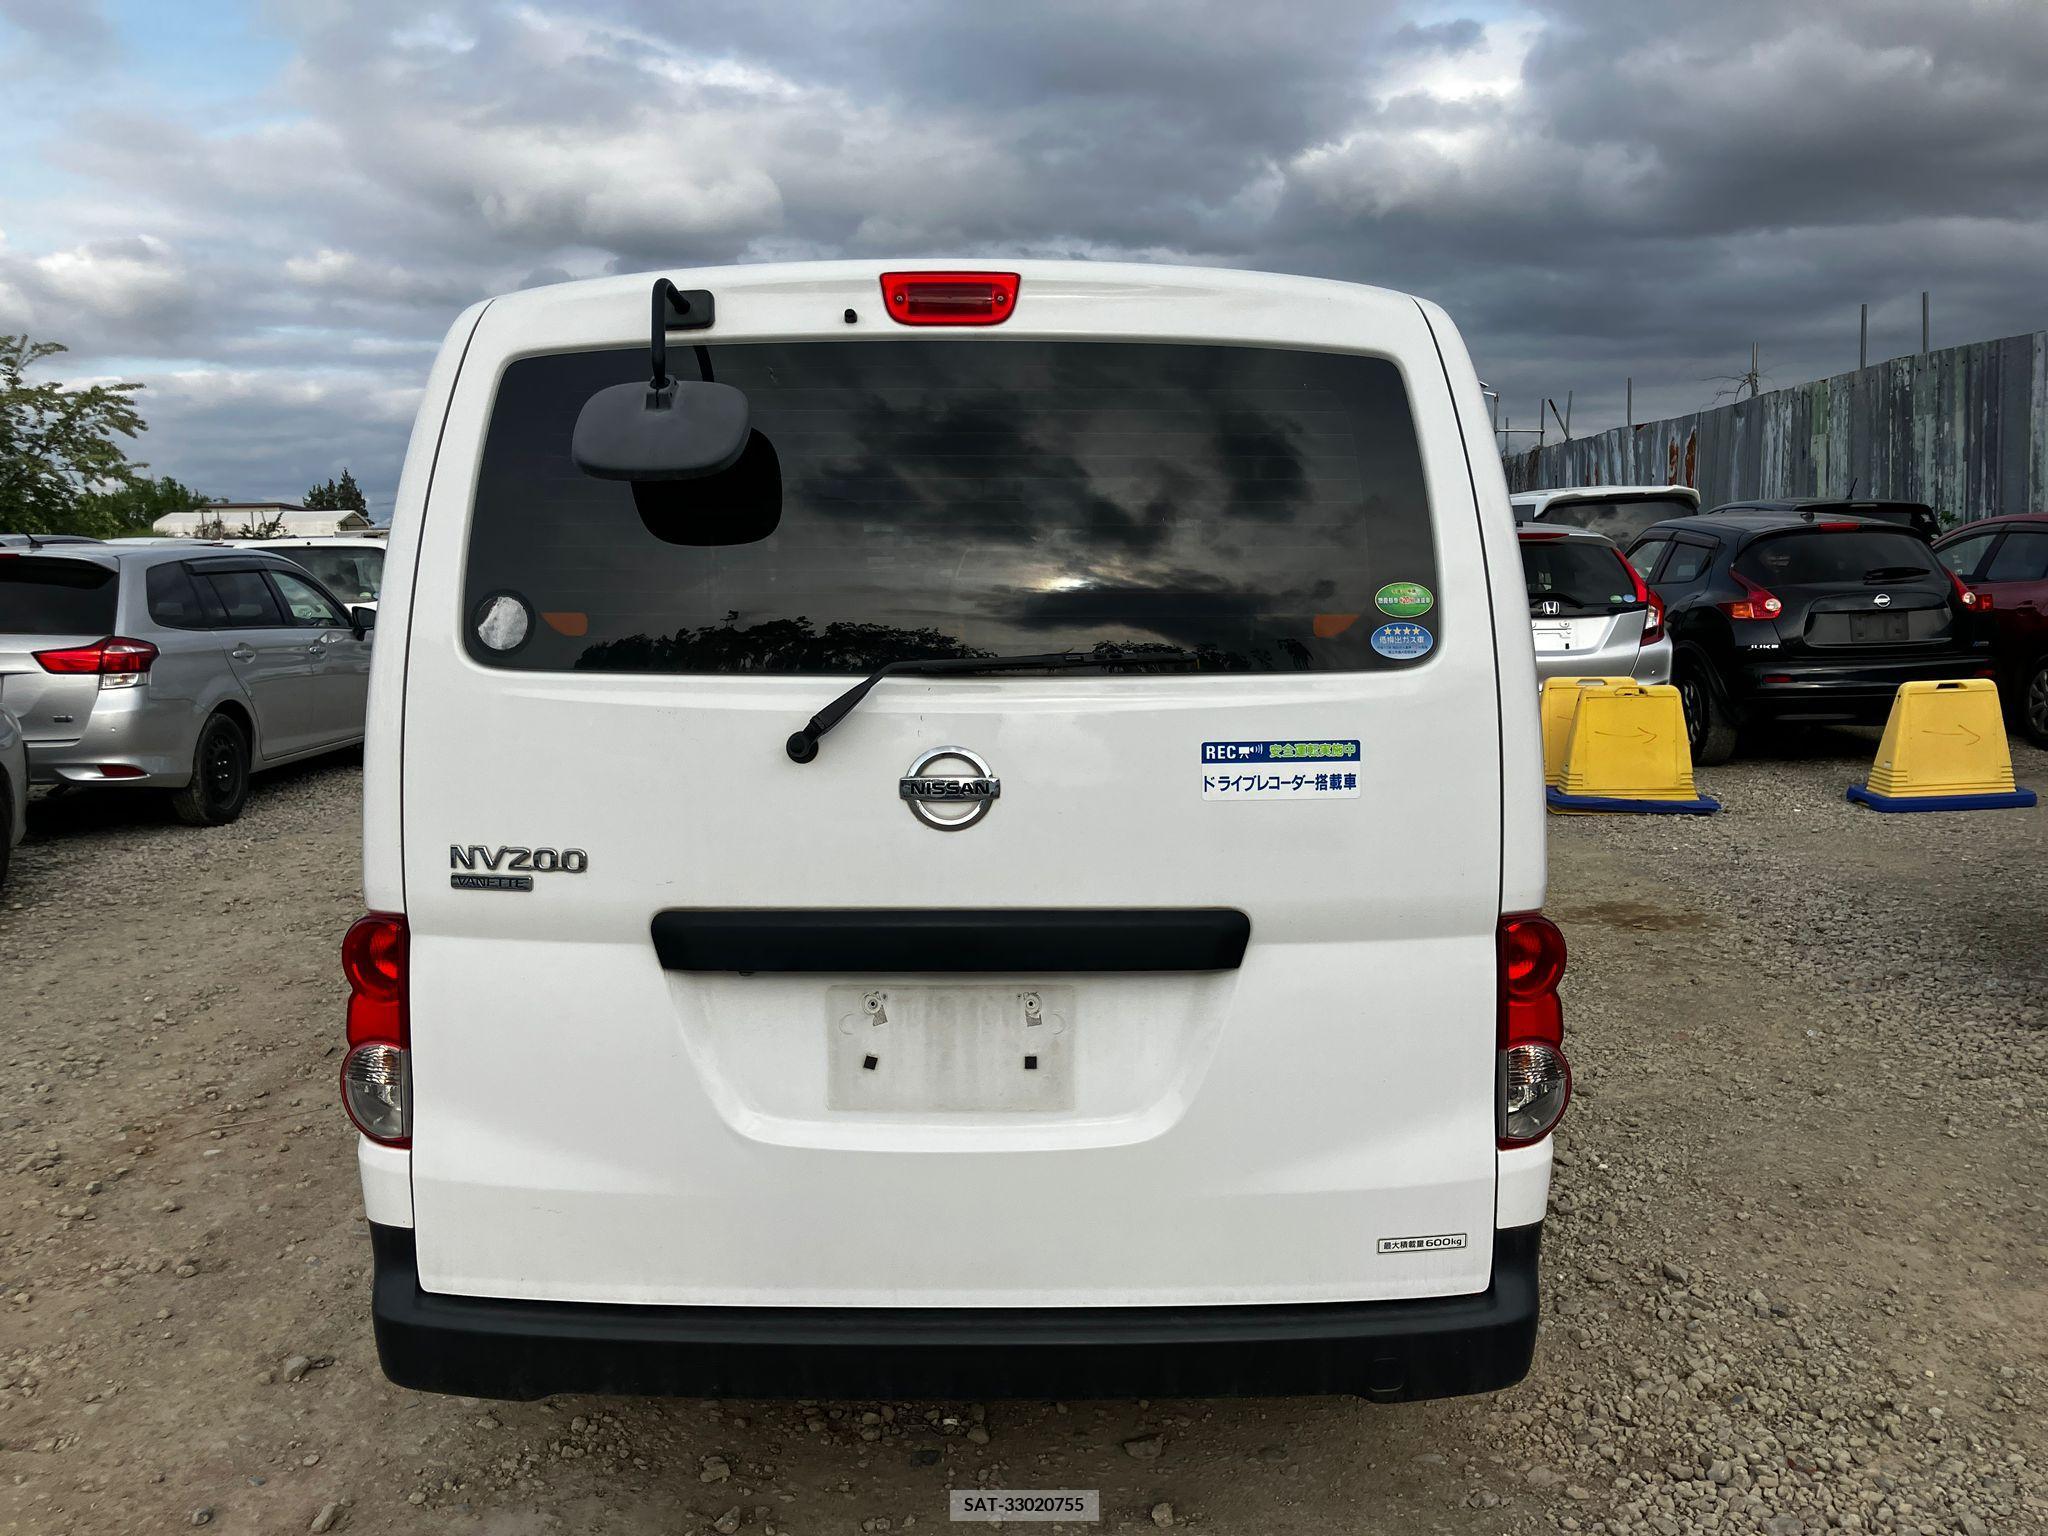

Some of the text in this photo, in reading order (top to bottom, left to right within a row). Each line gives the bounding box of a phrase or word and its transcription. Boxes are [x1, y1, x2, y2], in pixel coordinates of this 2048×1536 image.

[1205, 745, 1236, 760] REC
[910, 782, 990, 795] NISSAN
[1204, 773, 1357, 792] ドライブレコーダー搭載車
[450, 845, 588, 873] NV200
[457, 876, 525, 888] VANETTE
